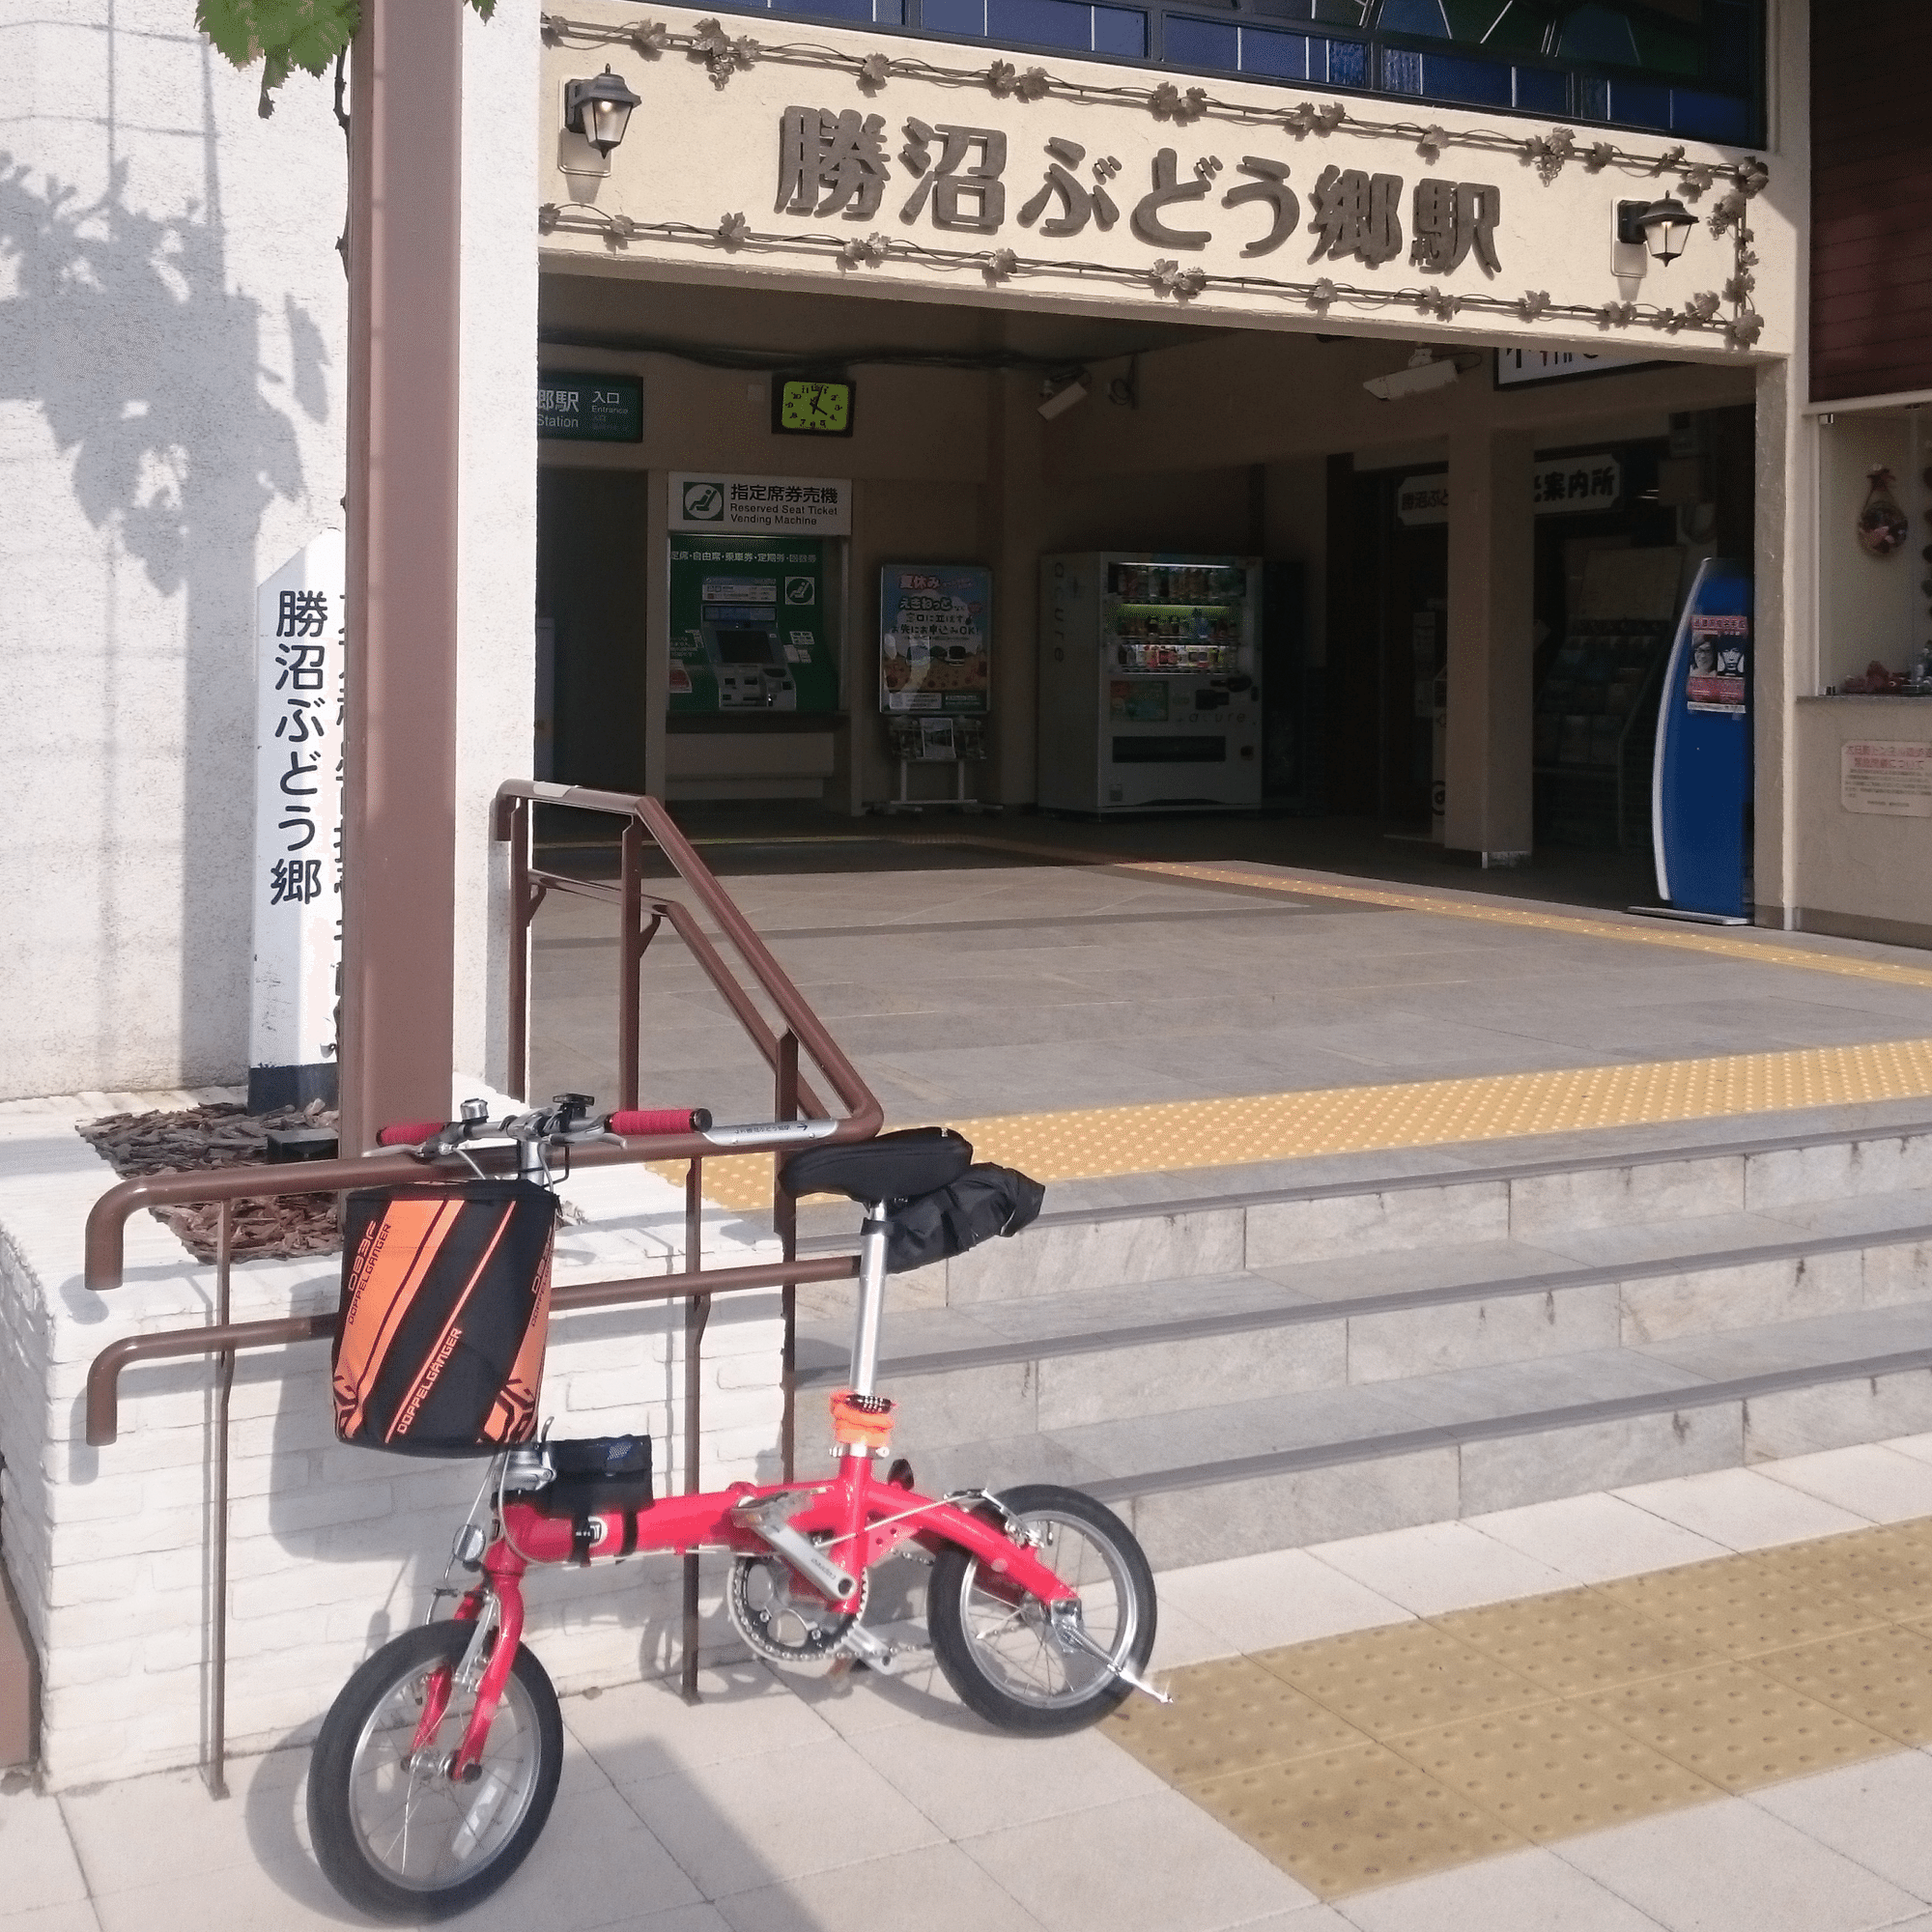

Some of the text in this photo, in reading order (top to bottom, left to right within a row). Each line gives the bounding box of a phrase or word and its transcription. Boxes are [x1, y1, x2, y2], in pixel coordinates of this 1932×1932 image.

[775, 104, 1502, 277] 勝沼ぶどう郷駅
[591, 391, 620, 404] 入口
[537, 413, 579, 428] Station
[1534, 466, 1614, 502] 案内所
[730, 484, 838, 503] 指定席券売機
[730, 503, 838, 516] Reserved Seat Ticket
[730, 514, 816, 526] Vending Machine
[899, 574, 940, 589] 夏休み
[899, 596, 952, 611] えきねっと
[270, 590, 328, 904] 勝沼ぶどう郷
